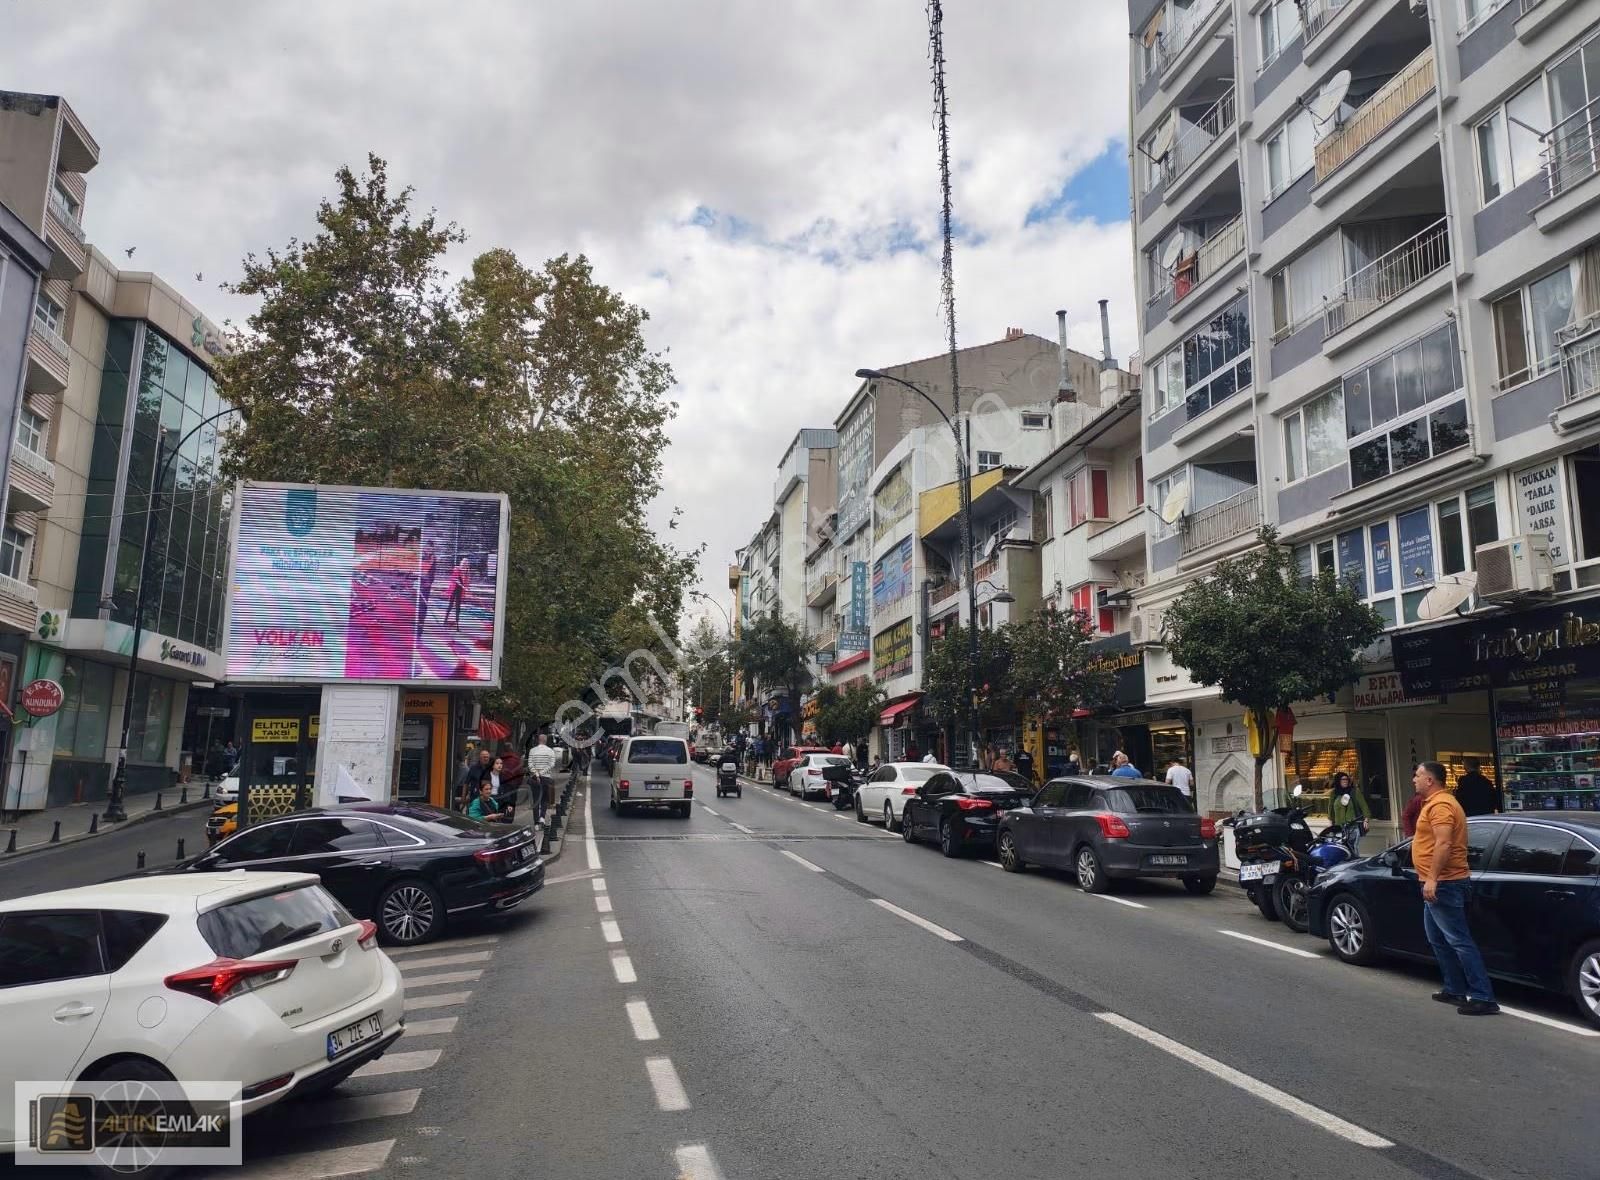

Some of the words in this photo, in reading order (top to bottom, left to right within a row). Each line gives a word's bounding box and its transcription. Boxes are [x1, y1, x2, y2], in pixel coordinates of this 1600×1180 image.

[254, 629, 324, 648] VOLKAN
[1525, 722, 1555, 736] TELEFON
[332, 1033, 344, 1051] 34
[347, 1023, 364, 1044] ZZE
